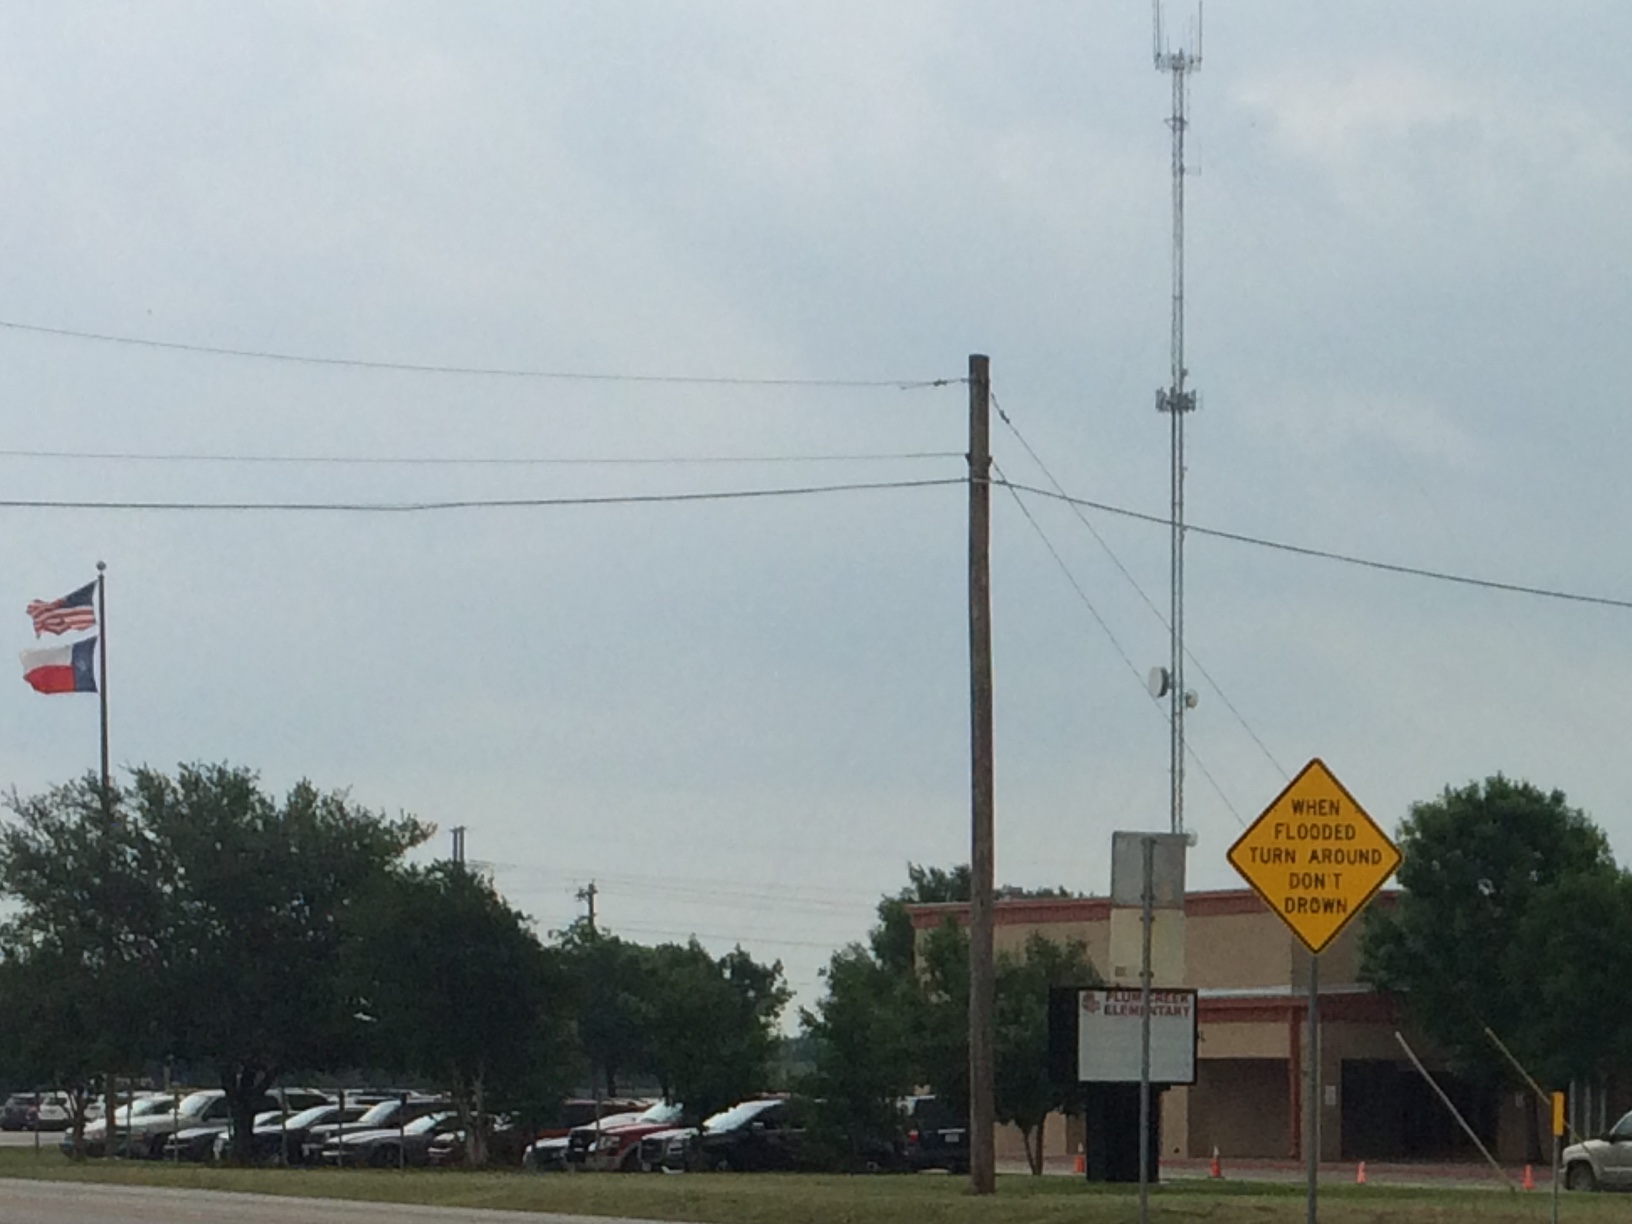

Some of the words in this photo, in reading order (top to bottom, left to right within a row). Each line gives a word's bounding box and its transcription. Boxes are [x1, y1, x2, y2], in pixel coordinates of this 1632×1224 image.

[1291, 799, 1340, 816] WHEN
[1274, 823, 1356, 840] FLOODED
[1250, 847, 1296, 864] TURN
[1308, 848, 1382, 865] AROUND
[1289, 872, 1343, 889] DON'T
[1284, 897, 1348, 914] DROWN
